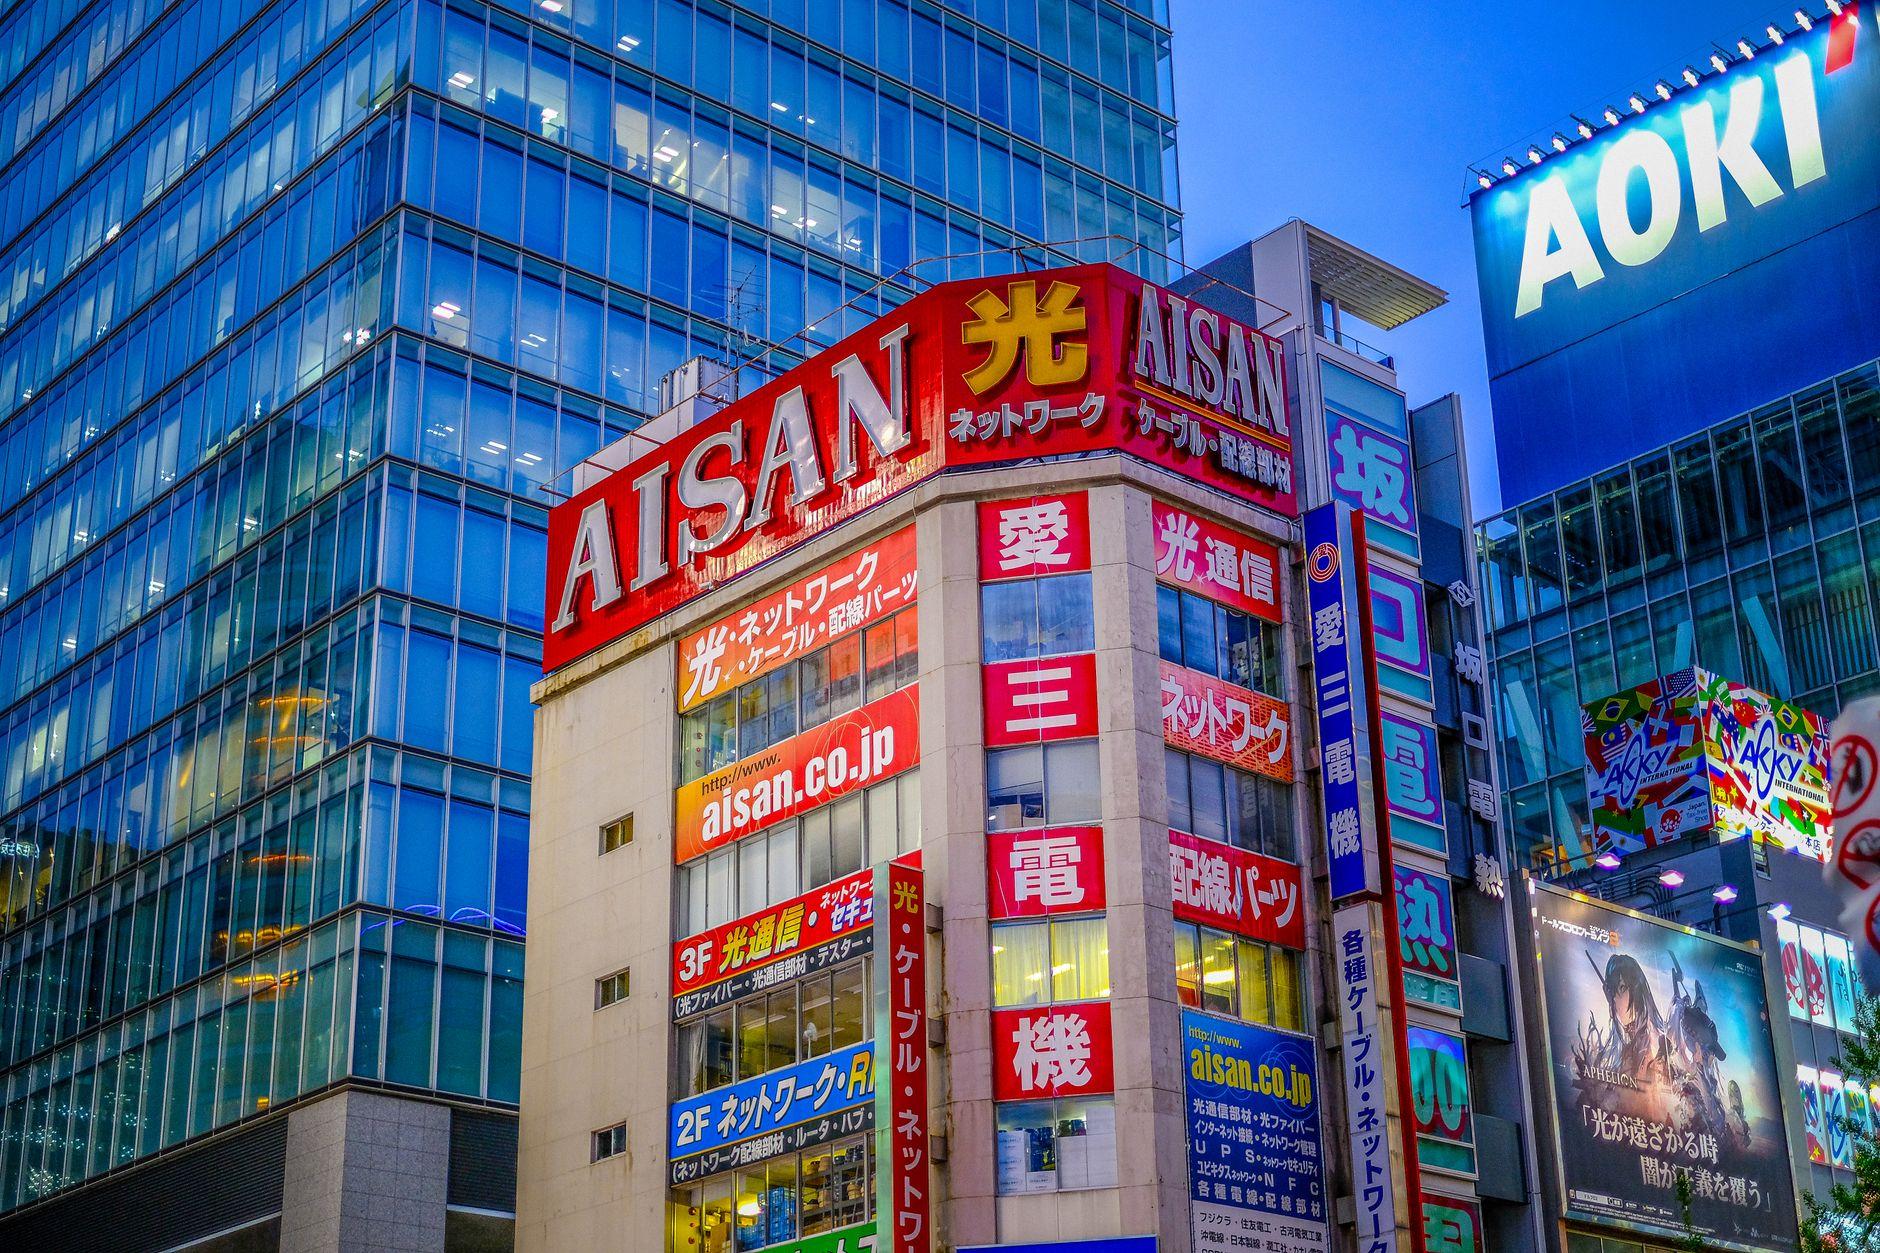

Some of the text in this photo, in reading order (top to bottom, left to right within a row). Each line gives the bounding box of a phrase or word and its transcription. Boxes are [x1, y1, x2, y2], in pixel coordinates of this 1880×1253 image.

[1514, 47, 1827, 319] AOKI
[962, 279, 1089, 396] 光
[1134, 282, 1290, 437] AISAN
[949, 392, 1106, 443] ネットワーク
[1137, 397, 1292, 495] ケーブル・配線部材
[551, 322, 911, 634] AISAN
[1155, 511, 1275, 606] 光通信
[683, 625, 729, 706] 光
[1161, 673, 1288, 764] ネットワーク
[1314, 601, 1361, 860] 愛三電機
[701, 753, 781, 796] http://www.
[701, 725, 894, 842] aisan.co.jp
[1455, 640, 1504, 899] 坂口電熱
[1639, 761, 1694, 785] INTERNATIONAL
[1774, 778, 1825, 803] INTERNATIONAL
[1168, 844, 1297, 928] 配線パーツ
[679, 941, 713, 982] 3F
[1188, 1025, 1242, 1049] http://www.
[1190, 1043, 1313, 1107] aisan.co.jp
[1583, 1065, 1638, 1089] APHELION
[676, 1051, 876, 1147] 2F ネットワーク・R
